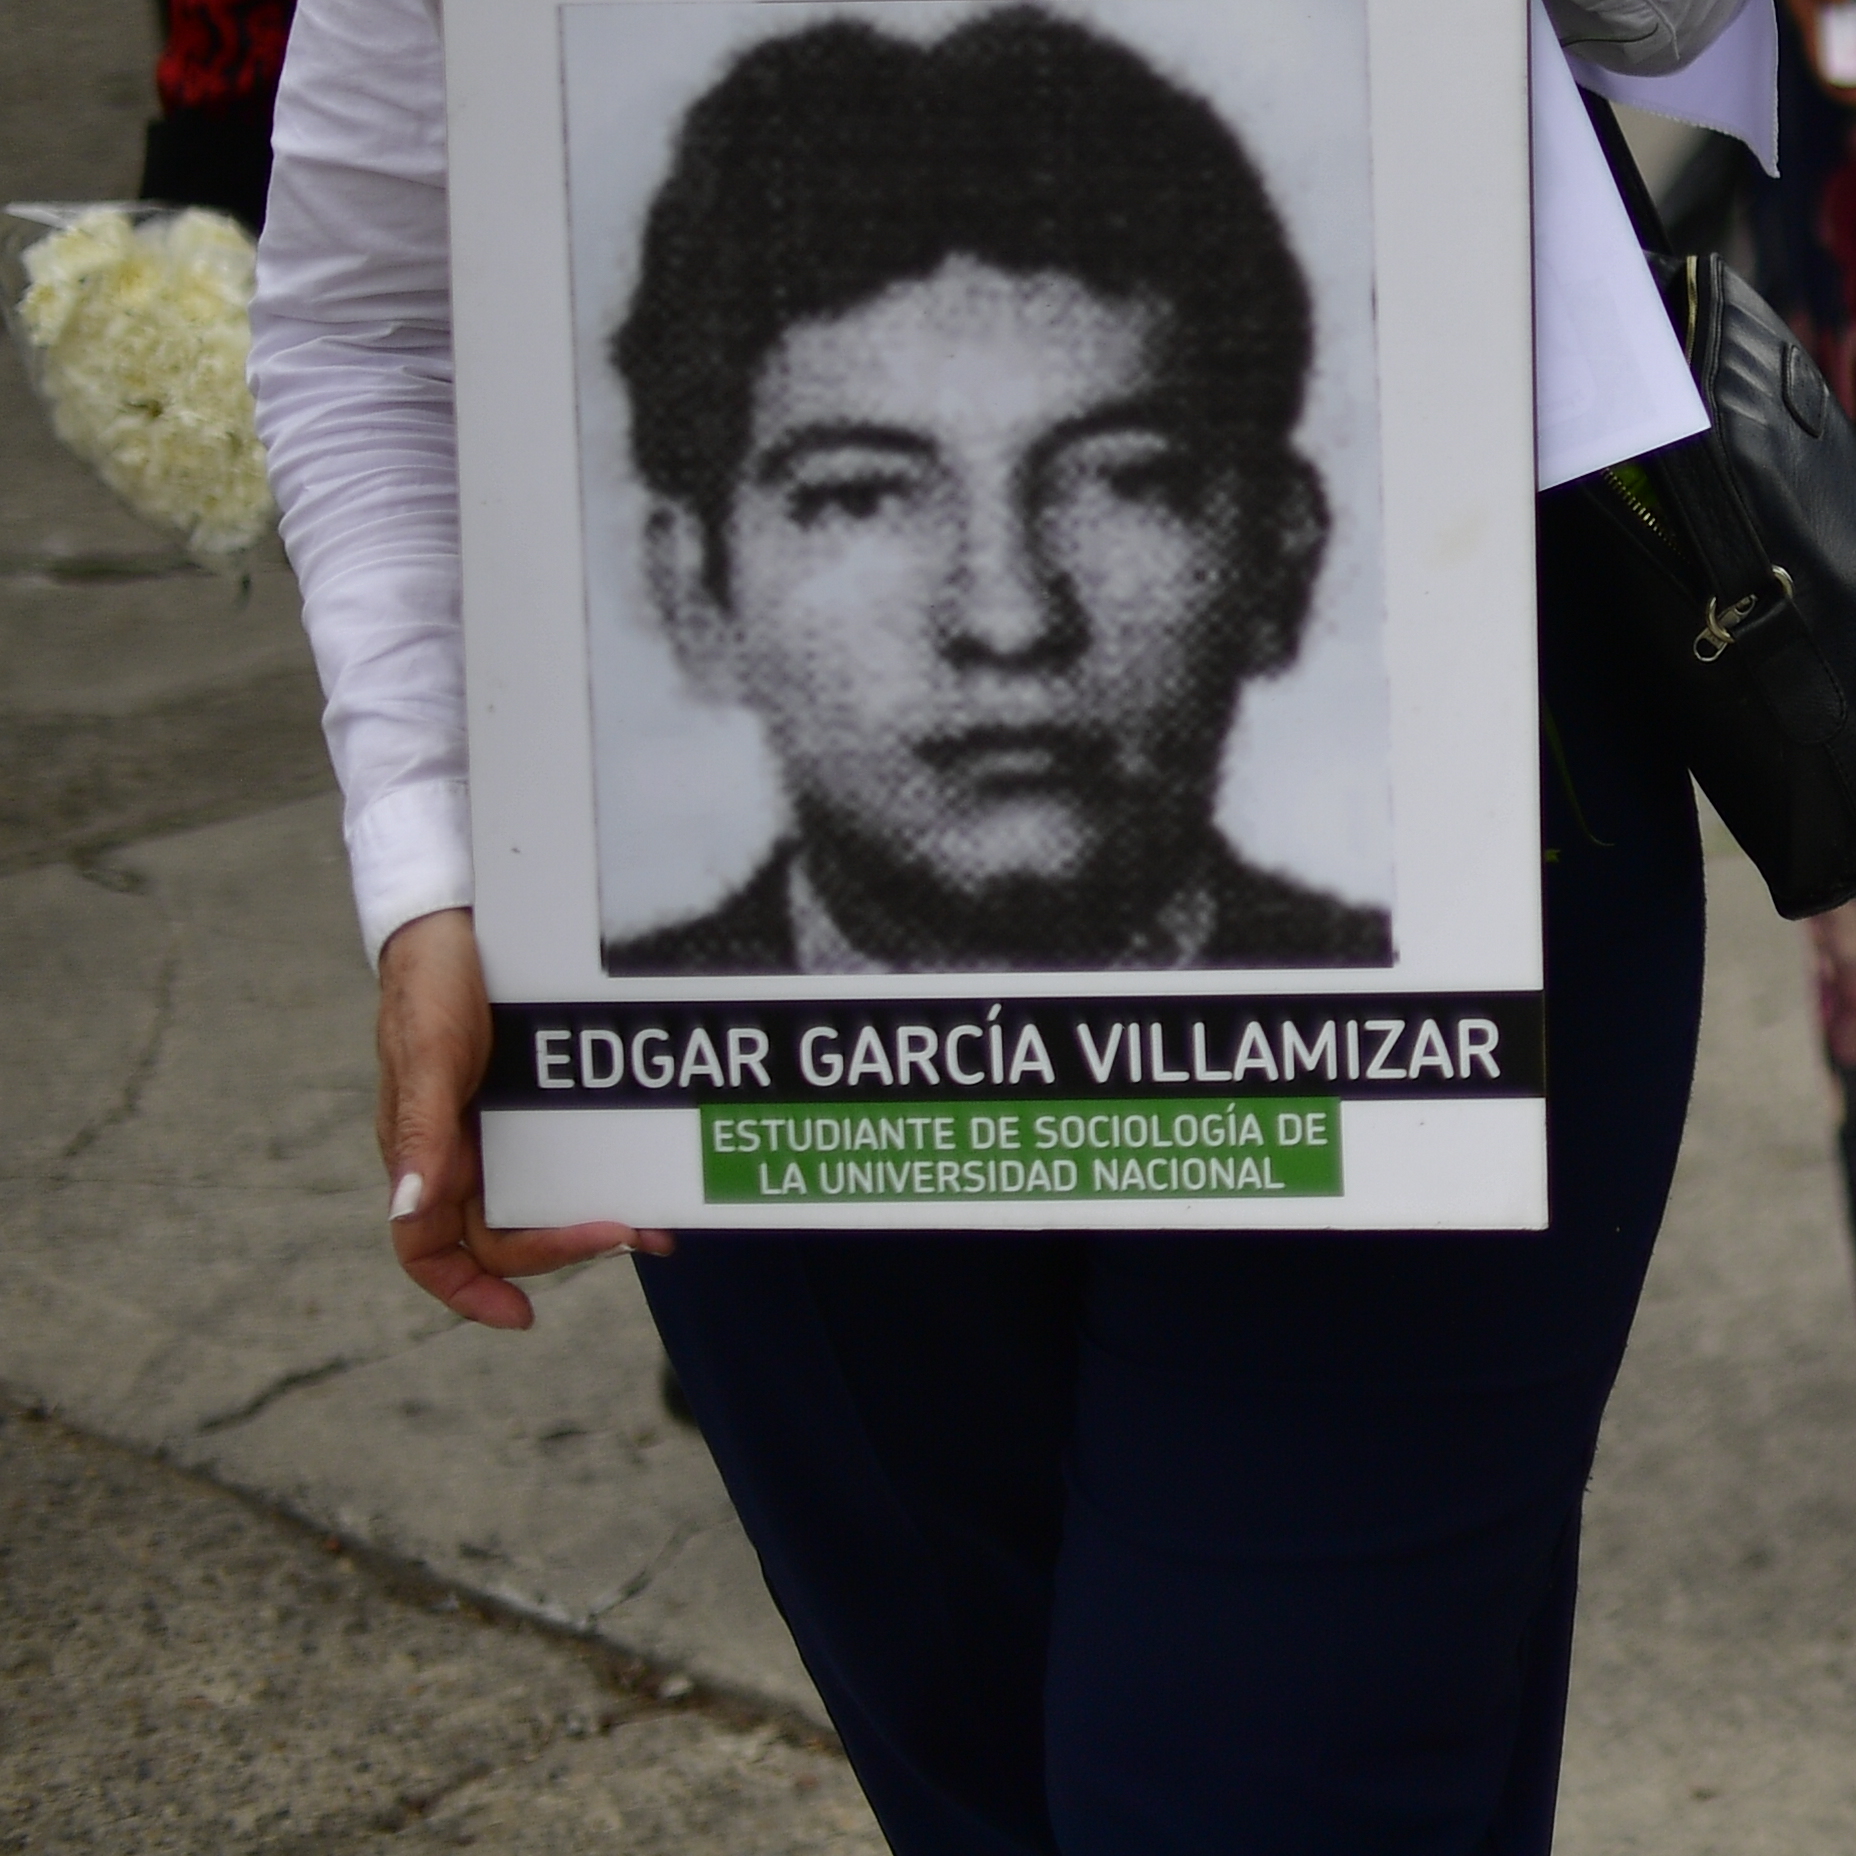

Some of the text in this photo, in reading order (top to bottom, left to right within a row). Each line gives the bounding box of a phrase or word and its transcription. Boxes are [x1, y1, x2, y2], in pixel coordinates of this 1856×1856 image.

[535, 1003, 1501, 1090] EDGAR GARCÍA VILLAMIZAR
[713, 1101, 1327, 1152] ESTUDIANTE DE SOCIOLOGÍA DE
[759, 1156, 1285, 1195] LA UNIVERSIDAD NACIONAL
